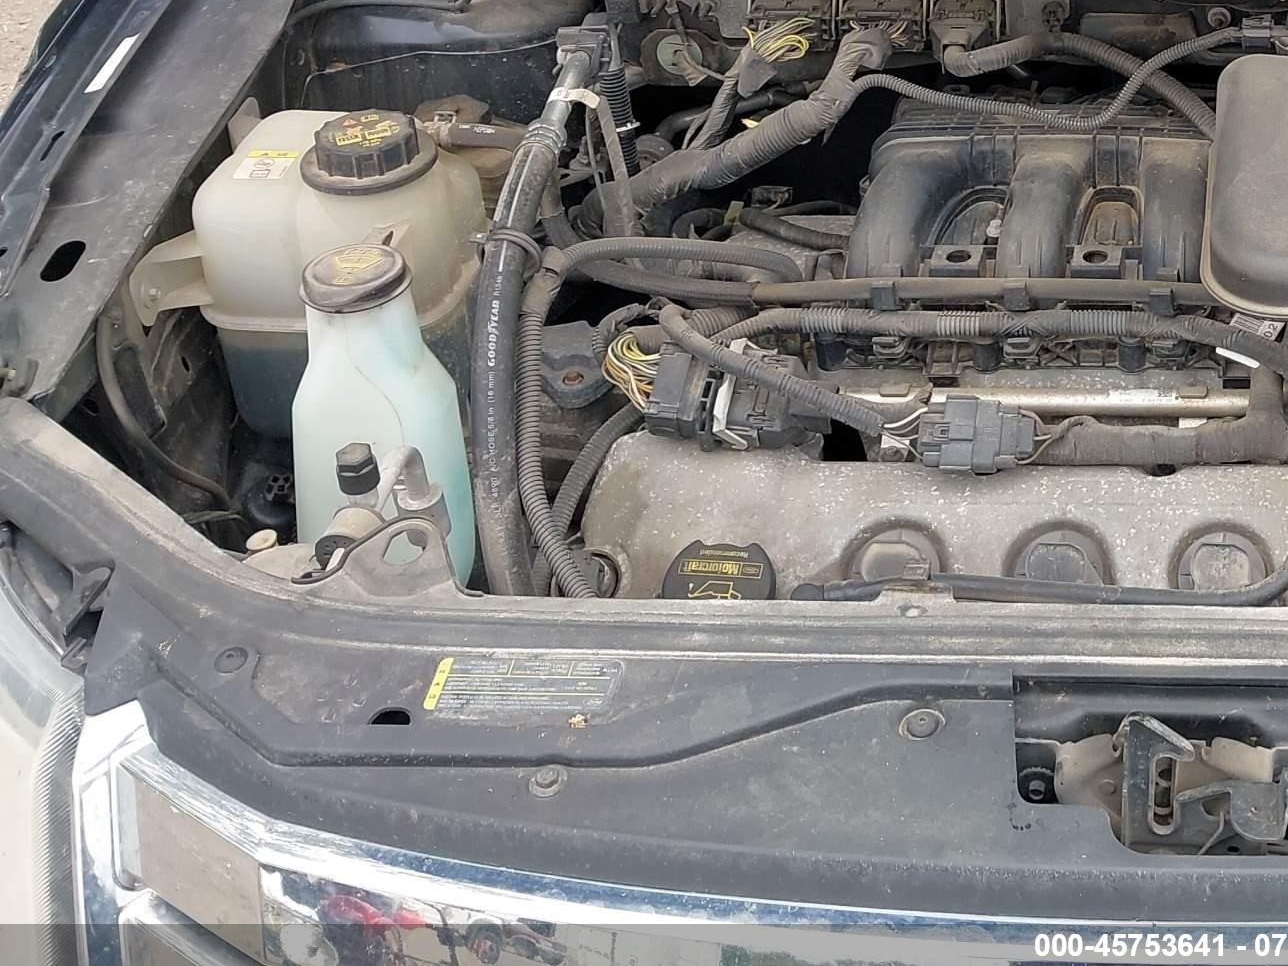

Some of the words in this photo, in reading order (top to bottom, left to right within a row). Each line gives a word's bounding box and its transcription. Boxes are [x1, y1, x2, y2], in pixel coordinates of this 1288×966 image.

[487, 300, 500, 366] GOODYEAR
[488, 430, 496, 455] HOSE
[683, 561, 740, 576] Motorcraft
